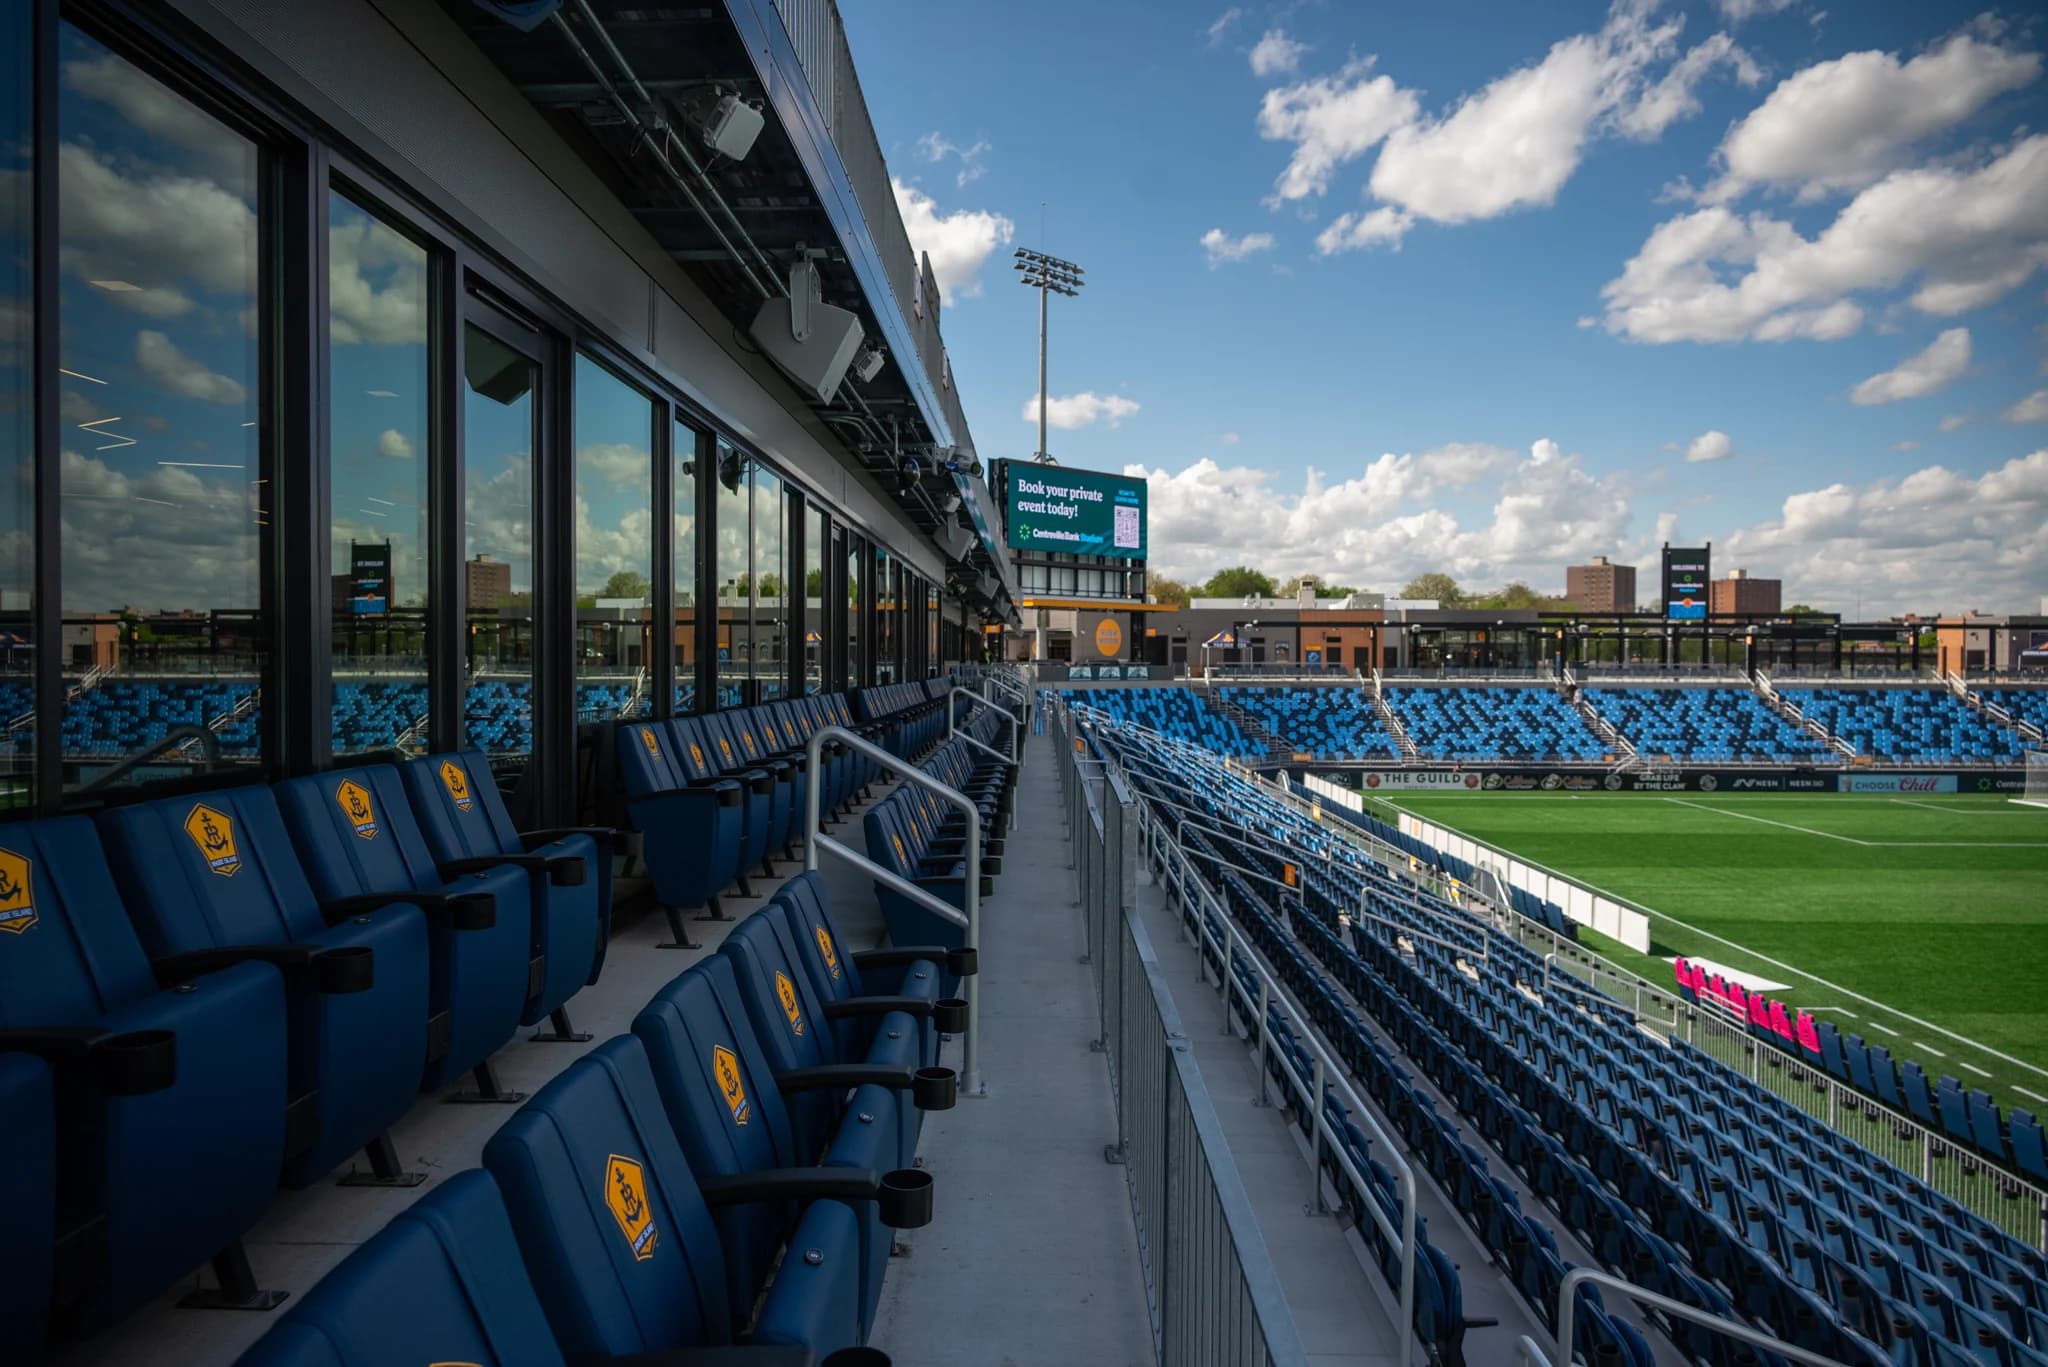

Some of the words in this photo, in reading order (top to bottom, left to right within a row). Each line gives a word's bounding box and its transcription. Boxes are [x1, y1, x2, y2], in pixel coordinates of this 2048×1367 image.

[1018, 479, 1045, 494] Book
[1045, 484, 1068, 498] your
[1069, 486, 1103, 502] private
[1018, 500, 1046, 514] event
[1047, 502, 1078, 519] today!
[1383, 773, 1410, 783] THE
[1416, 773, 1461, 784] GUILD
[1855, 781, 1895, 790] CHOOSE
[1899, 775, 1939, 791] Chill
